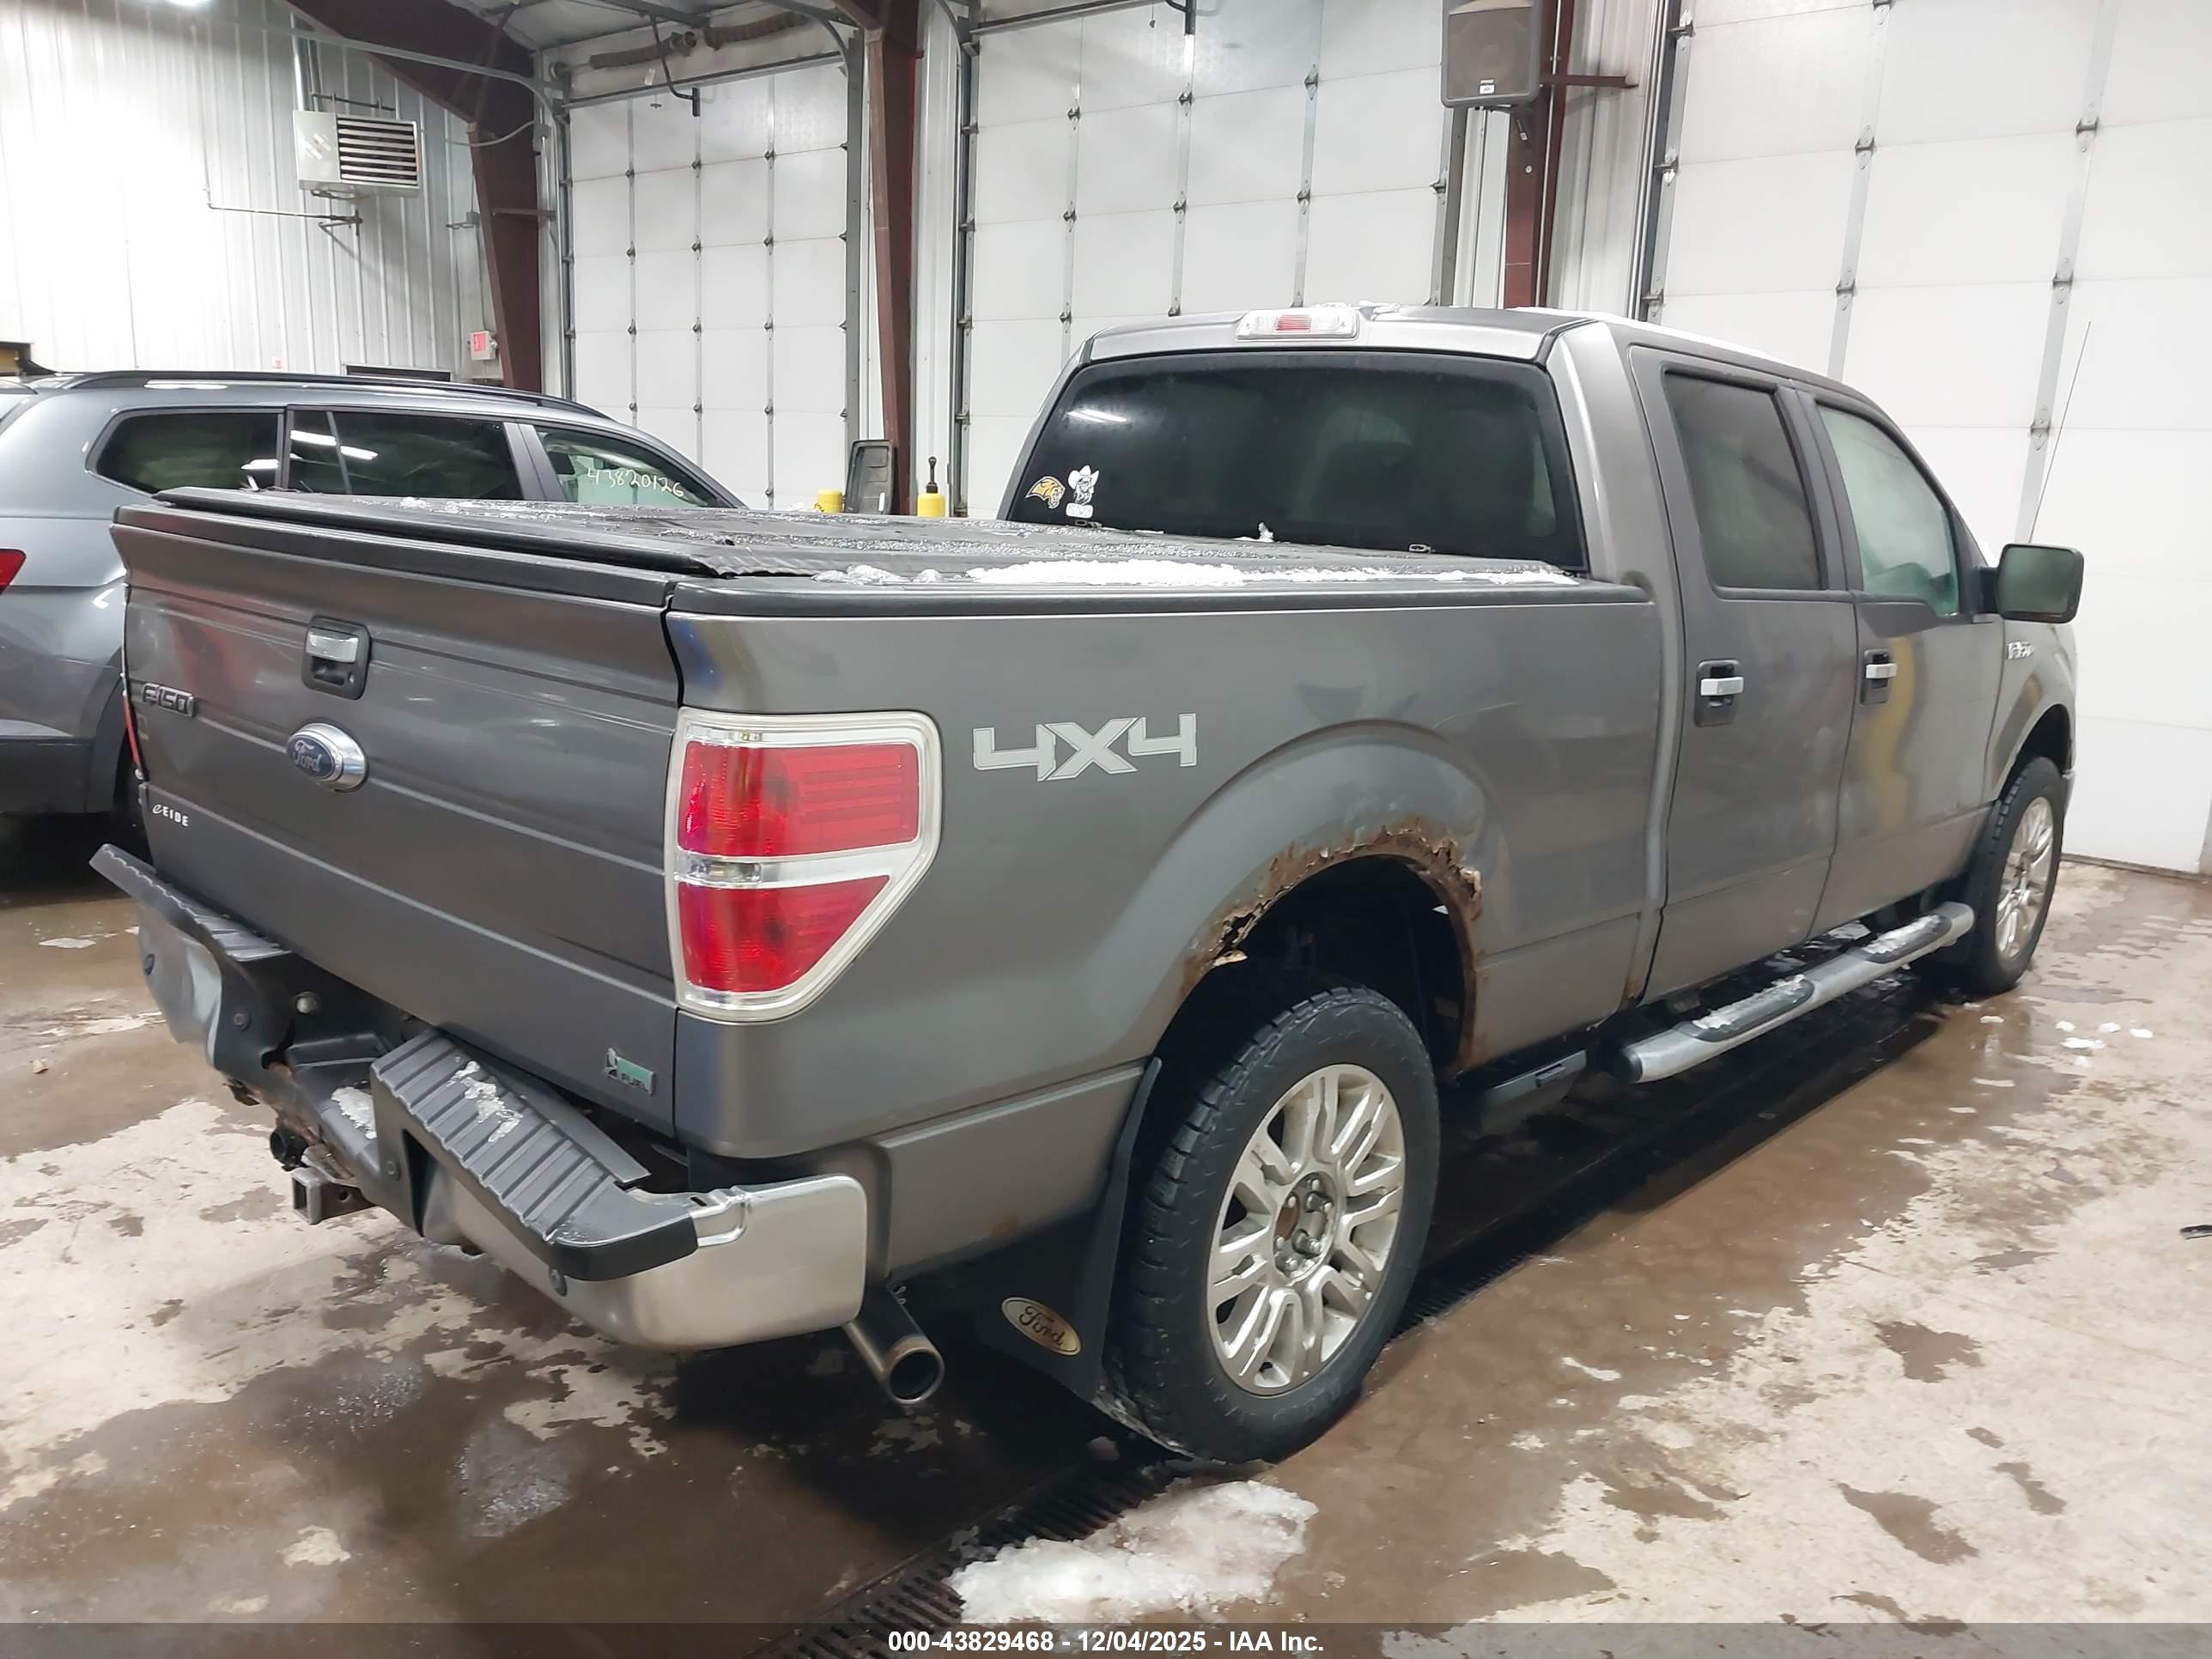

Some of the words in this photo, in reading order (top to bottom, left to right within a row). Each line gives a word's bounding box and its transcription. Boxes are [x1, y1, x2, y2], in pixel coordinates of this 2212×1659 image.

[587, 467, 684, 497] 43820126
[293, 739, 323, 773] Ford
[1018, 1305, 1066, 1346] Ford
